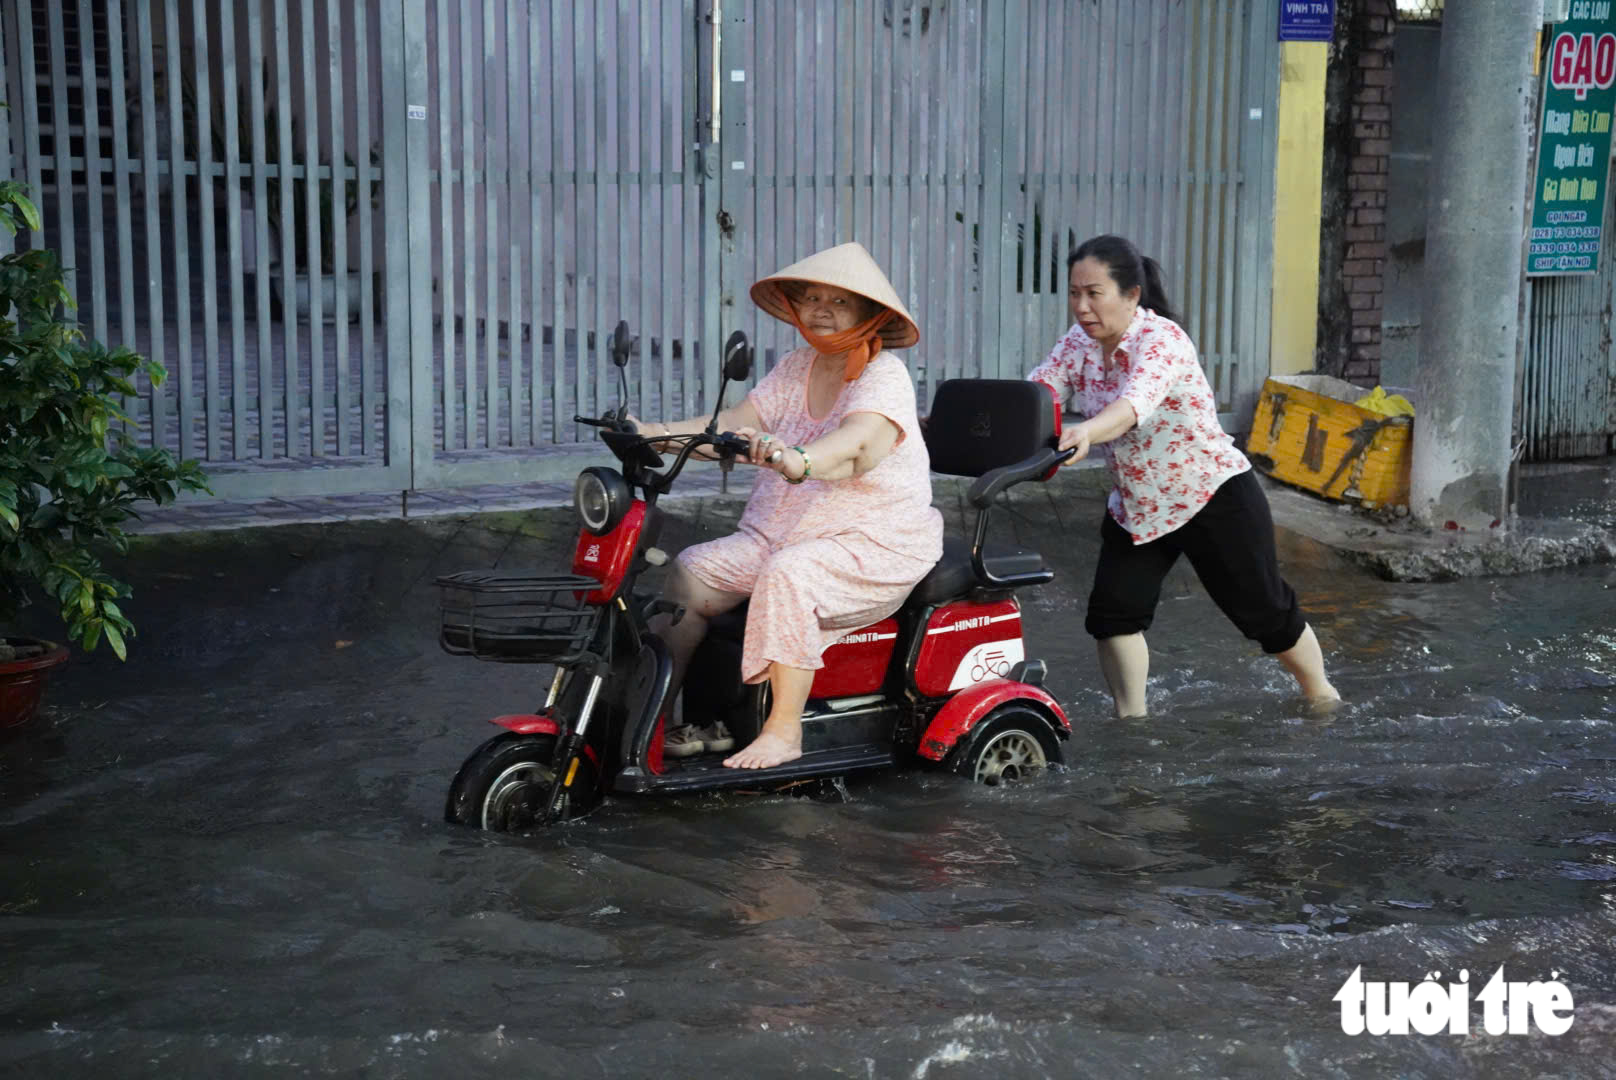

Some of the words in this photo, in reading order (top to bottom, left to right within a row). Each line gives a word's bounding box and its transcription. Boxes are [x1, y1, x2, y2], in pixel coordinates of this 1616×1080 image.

[1551, 32, 1616, 100] GẠO
[1535, 256, 1554, 269] SHIP
[954, 615, 991, 632] HINATA
[846, 632, 879, 645] HINATA
